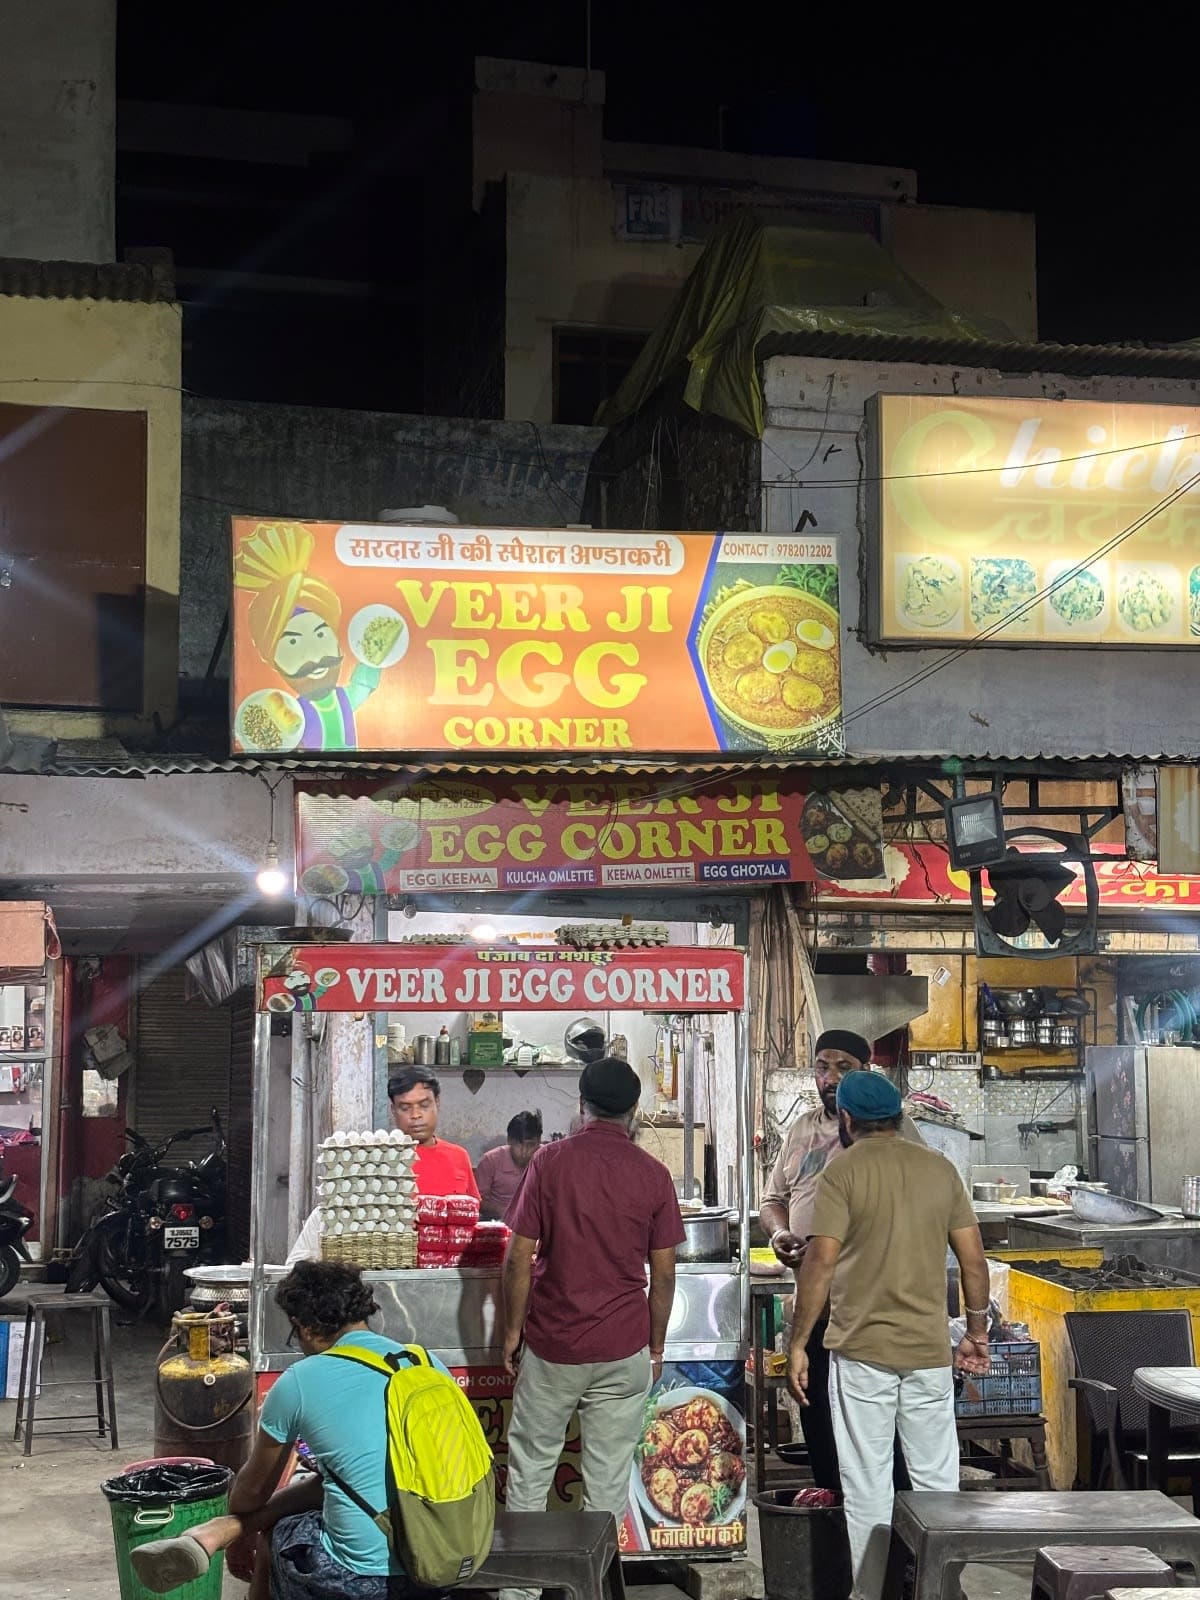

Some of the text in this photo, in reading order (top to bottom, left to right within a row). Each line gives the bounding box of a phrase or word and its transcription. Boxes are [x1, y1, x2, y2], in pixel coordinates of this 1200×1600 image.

[349, 537, 421, 561] सरदार
[426, 533, 455, 562] जी
[459, 535, 493, 562] की
[723, 542, 768, 556] CONTACT
[777, 543, 832, 558] 9782012202
[396, 579, 673, 633] VEER JI
[426, 639, 648, 708] EGG
[443, 716, 632, 748] CORNER
[512, 779, 782, 818] VEER JI
[427, 817, 791, 864] EGG CORNER
[406, 871, 493, 886] EGG KEEMA
[506, 869, 595, 884] KULCHA OMLETTE
[606, 866, 691, 882] KEEMA OMLETTE
[703, 864, 787, 878] EGG GHOTALA
[535, 951, 555, 962] दा
[345, 967, 734, 1004] VEER JI EGG CORNER
[166, 1237, 198, 1248] 7575
[650, 1521, 694, 1547] पंजाबी
[718, 1521, 746, 1545] करी
